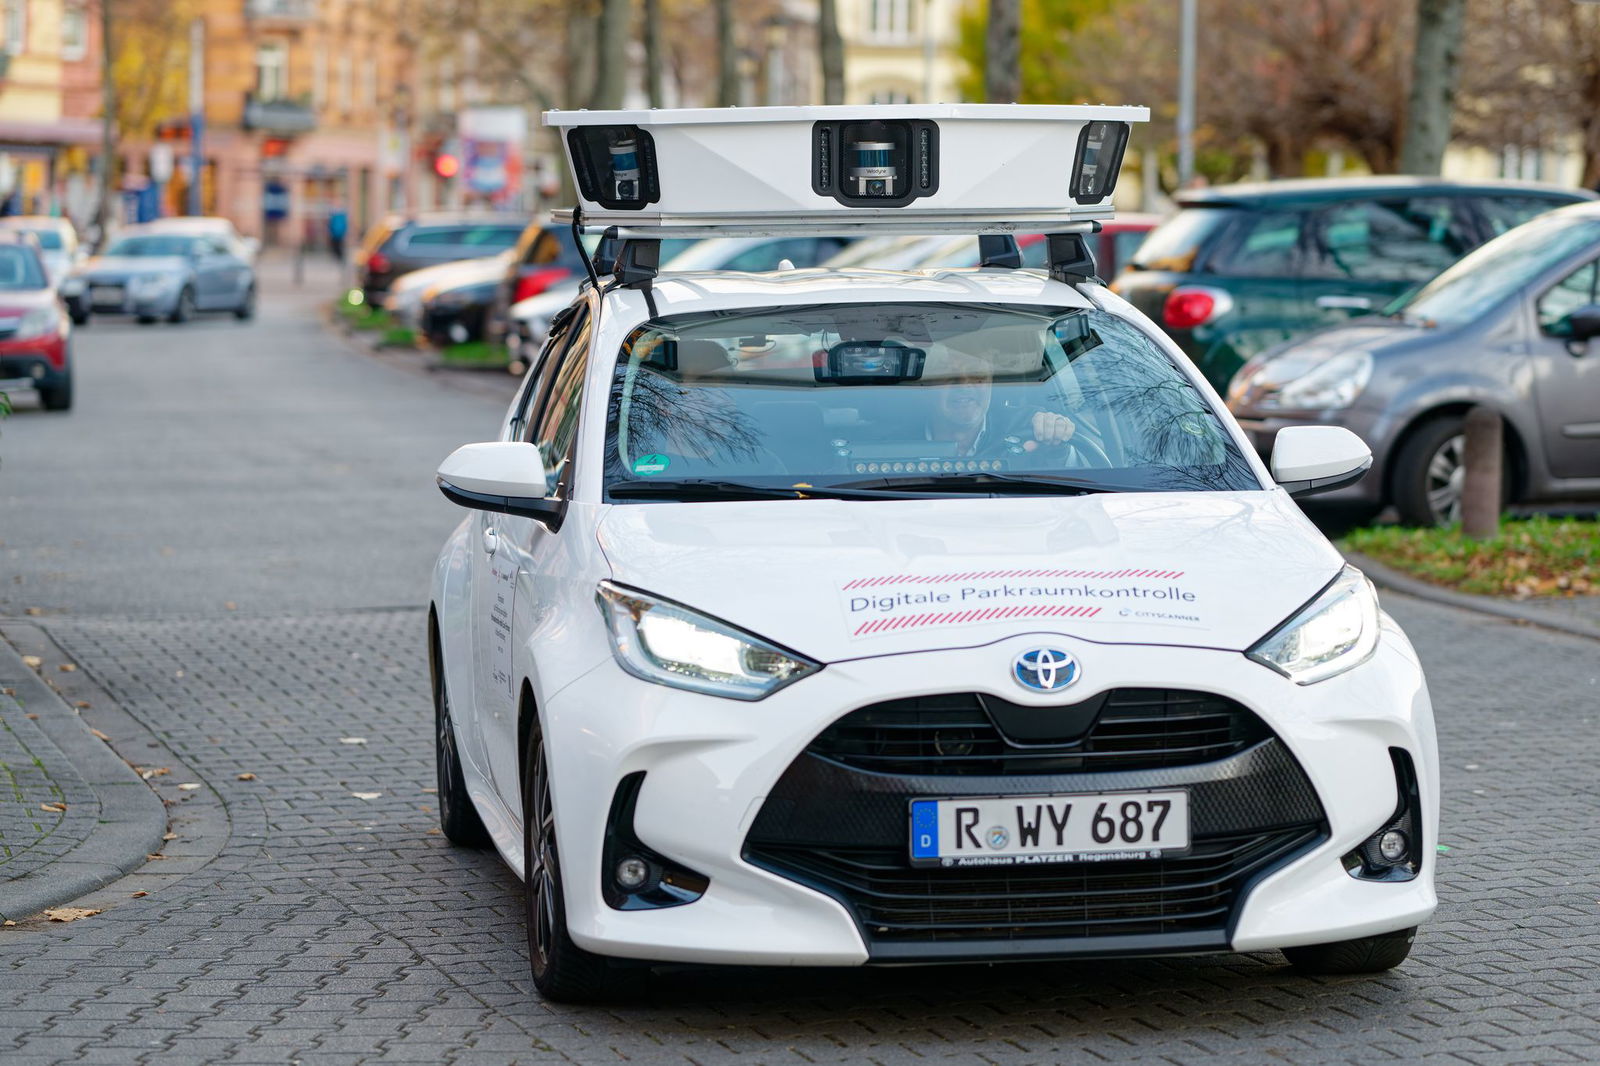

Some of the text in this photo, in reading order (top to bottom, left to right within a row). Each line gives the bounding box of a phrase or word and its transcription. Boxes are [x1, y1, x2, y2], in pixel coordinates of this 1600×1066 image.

[851, 584, 1196, 612] Digitale Parkraumkontrolle
[955, 800, 1171, 849] R WY 687
[920, 834, 931, 848] D
[958, 856, 1013, 866] Autohaus
[1078, 850, 1146, 862] Regensburg
